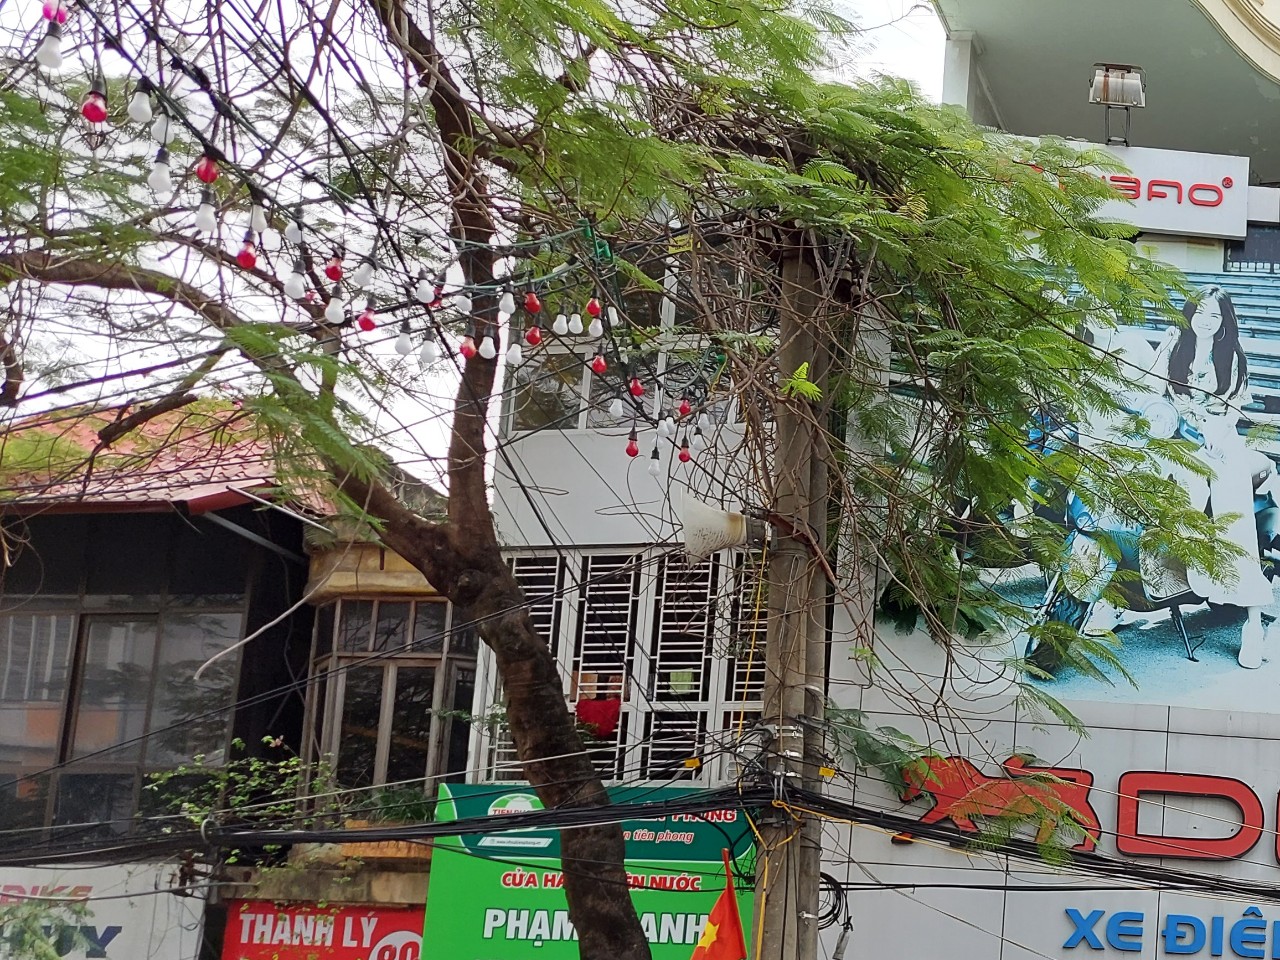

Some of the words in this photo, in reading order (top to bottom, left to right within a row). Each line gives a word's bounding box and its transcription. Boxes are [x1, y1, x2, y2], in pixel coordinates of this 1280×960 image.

[1101, 175, 1223, 207] BAO
[655, 829, 694, 844] phong
[502, 868, 539, 889] CỬA
[649, 872, 702, 892] NƯỚC
[342, 911, 378, 948] LÝ
[483, 908, 579, 948] PHẠM
[1062, 908, 1146, 952] XE
